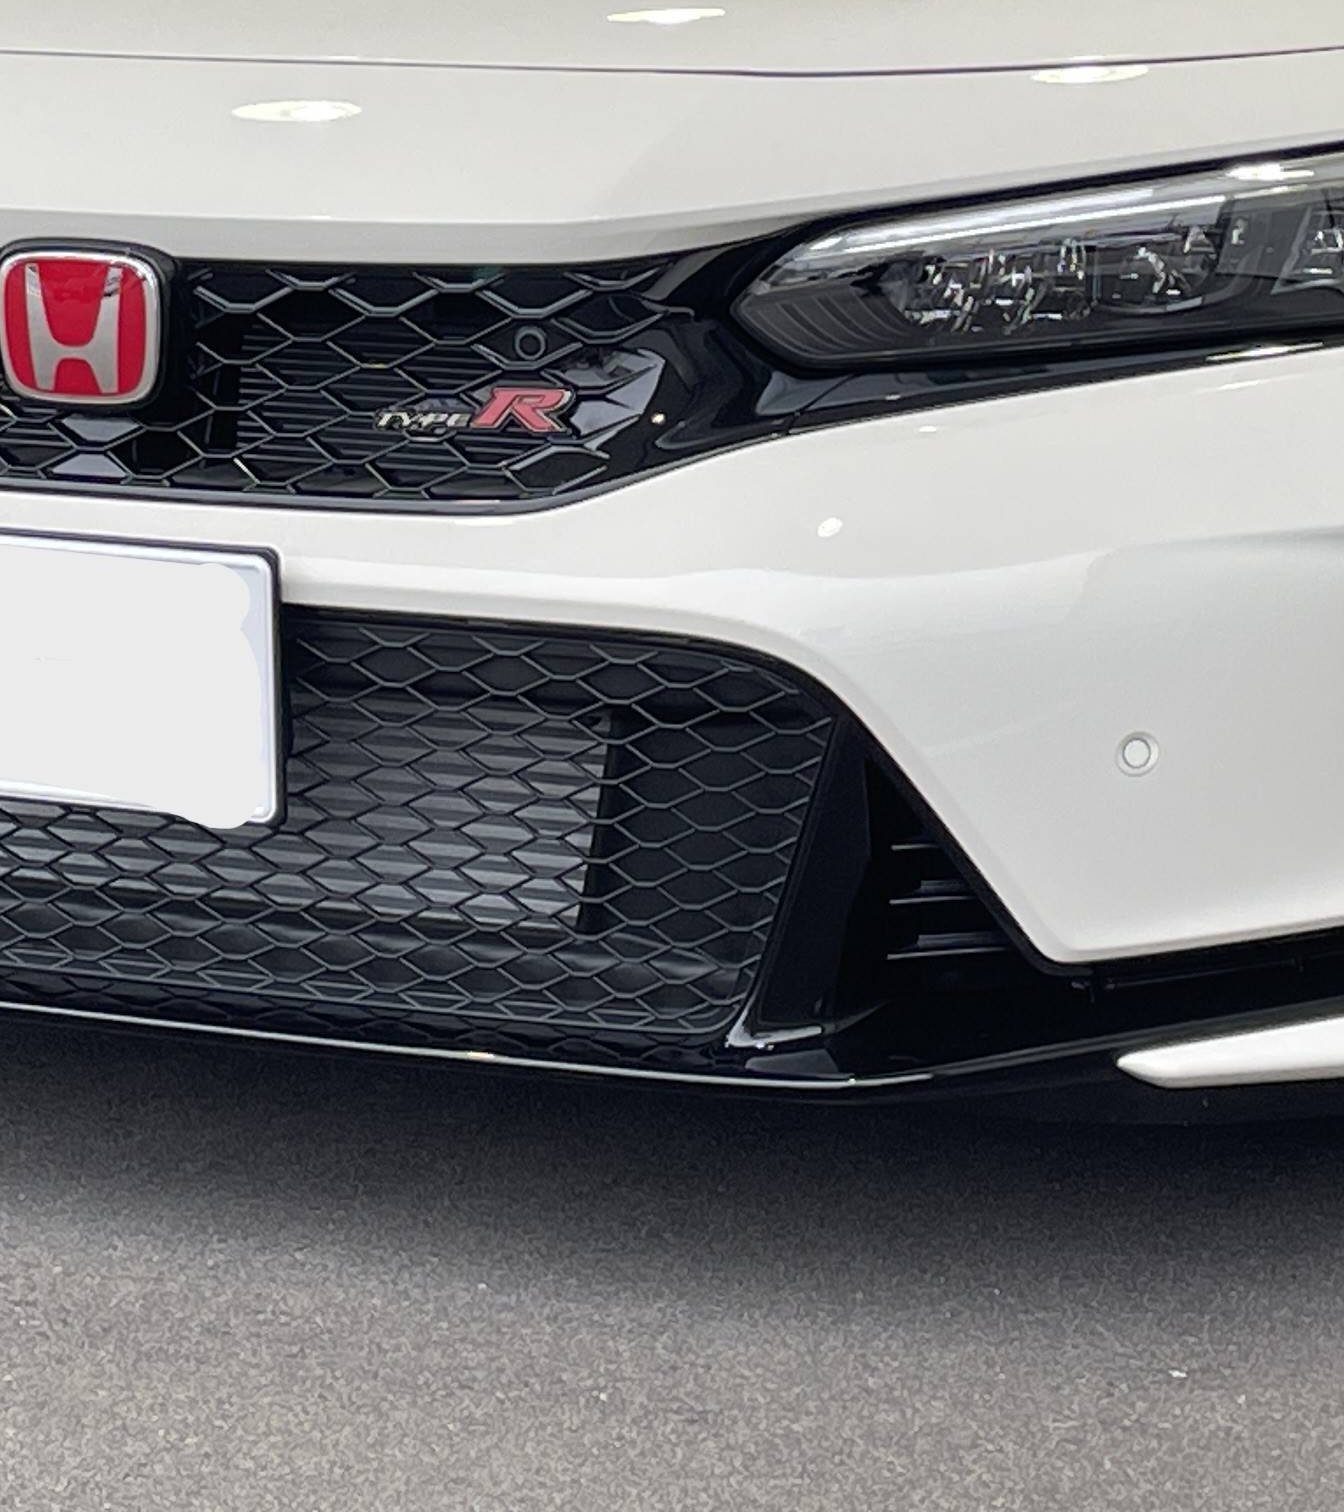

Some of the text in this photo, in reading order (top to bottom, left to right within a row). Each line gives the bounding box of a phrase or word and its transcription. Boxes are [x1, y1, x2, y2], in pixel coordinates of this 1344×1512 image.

[23, 262, 124, 395] H
[376, 385, 573, 434] TYPE R
